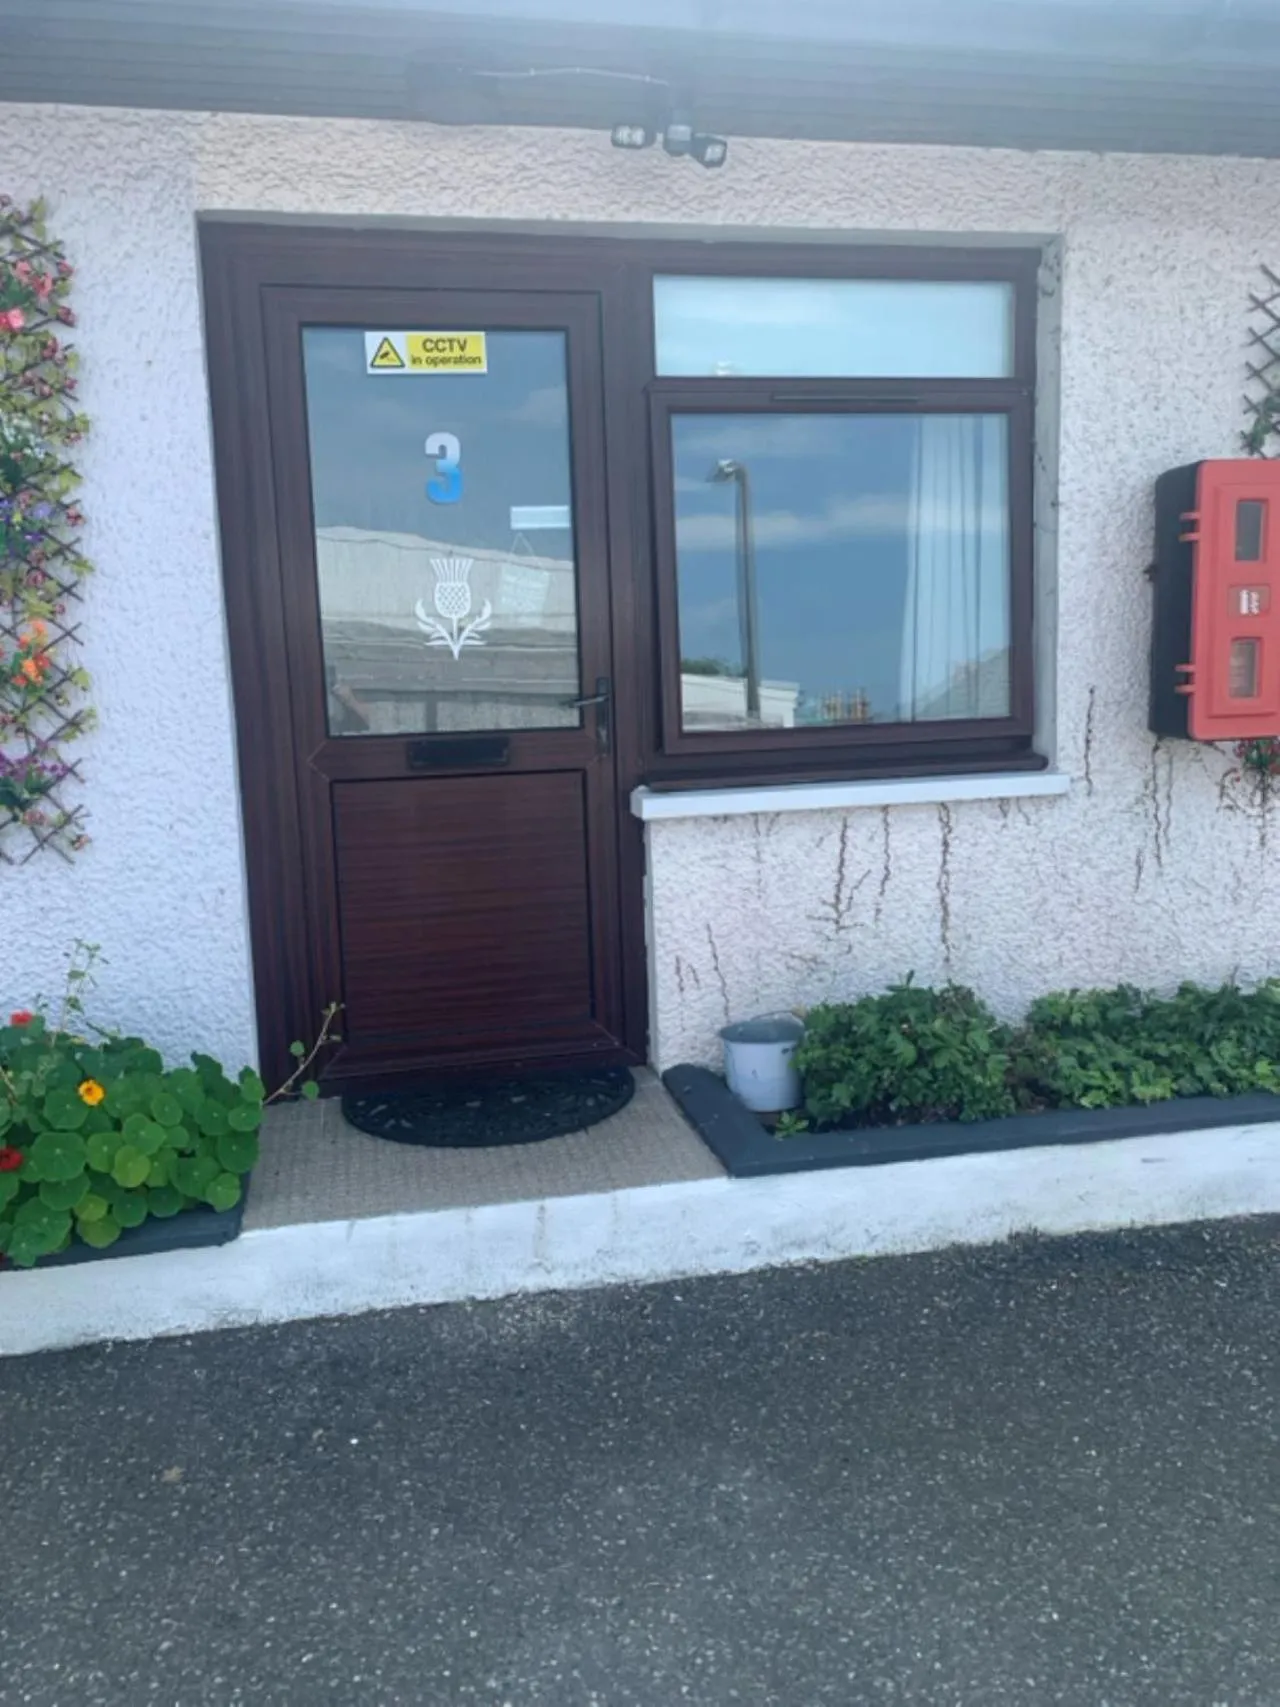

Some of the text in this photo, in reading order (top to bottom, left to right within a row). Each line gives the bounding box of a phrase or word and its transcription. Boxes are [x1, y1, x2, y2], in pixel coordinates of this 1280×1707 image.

[422, 338, 467, 353] CCTV
[411, 355, 481, 367] in operation
[425, 432, 463, 504] 3
